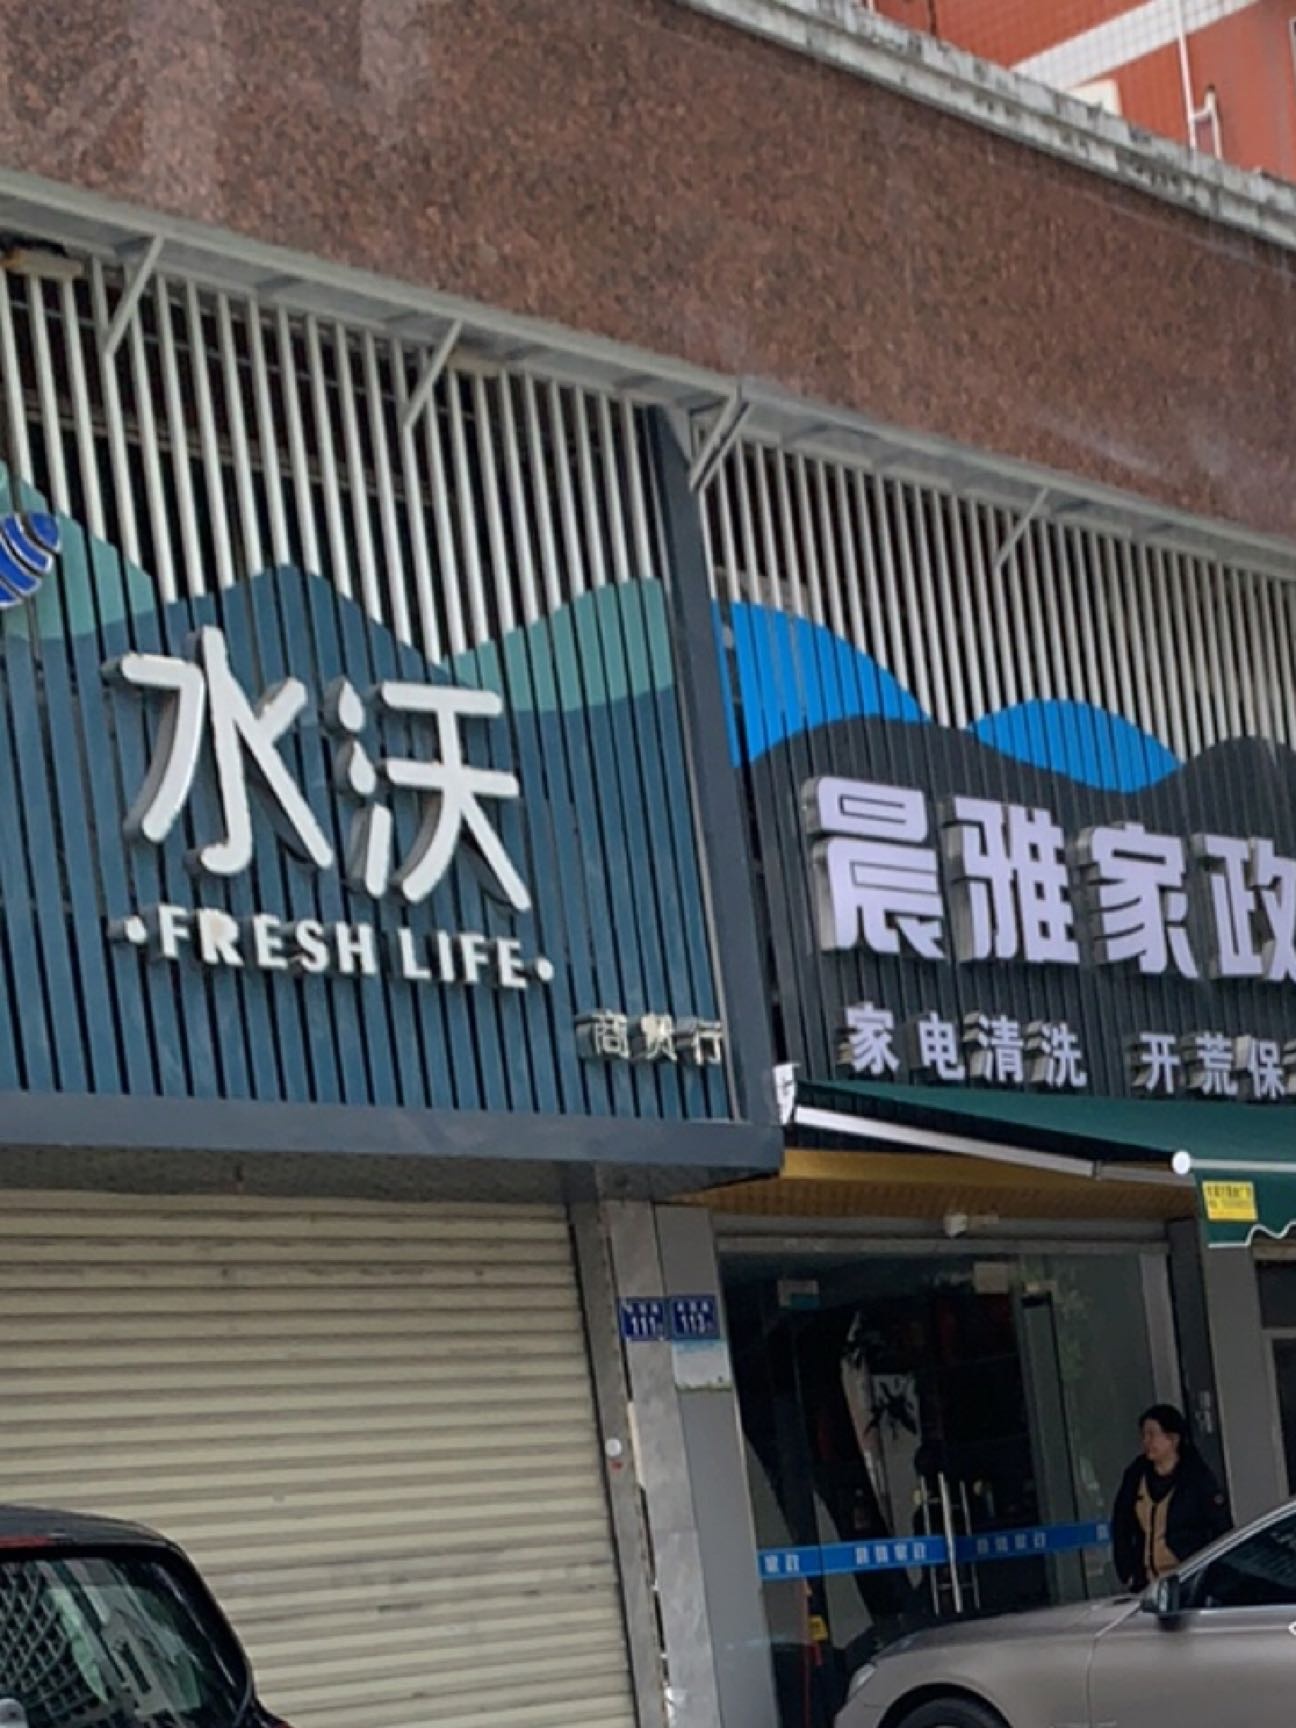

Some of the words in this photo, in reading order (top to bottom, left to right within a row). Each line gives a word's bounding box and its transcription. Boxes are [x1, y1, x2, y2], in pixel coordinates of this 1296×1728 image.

[120, 626, 533, 912] 水沃
[159, 904, 377, 977] FRESH
[400, 927, 529, 990] LIFE
[846, 1001, 1088, 1089] 家电清洗
